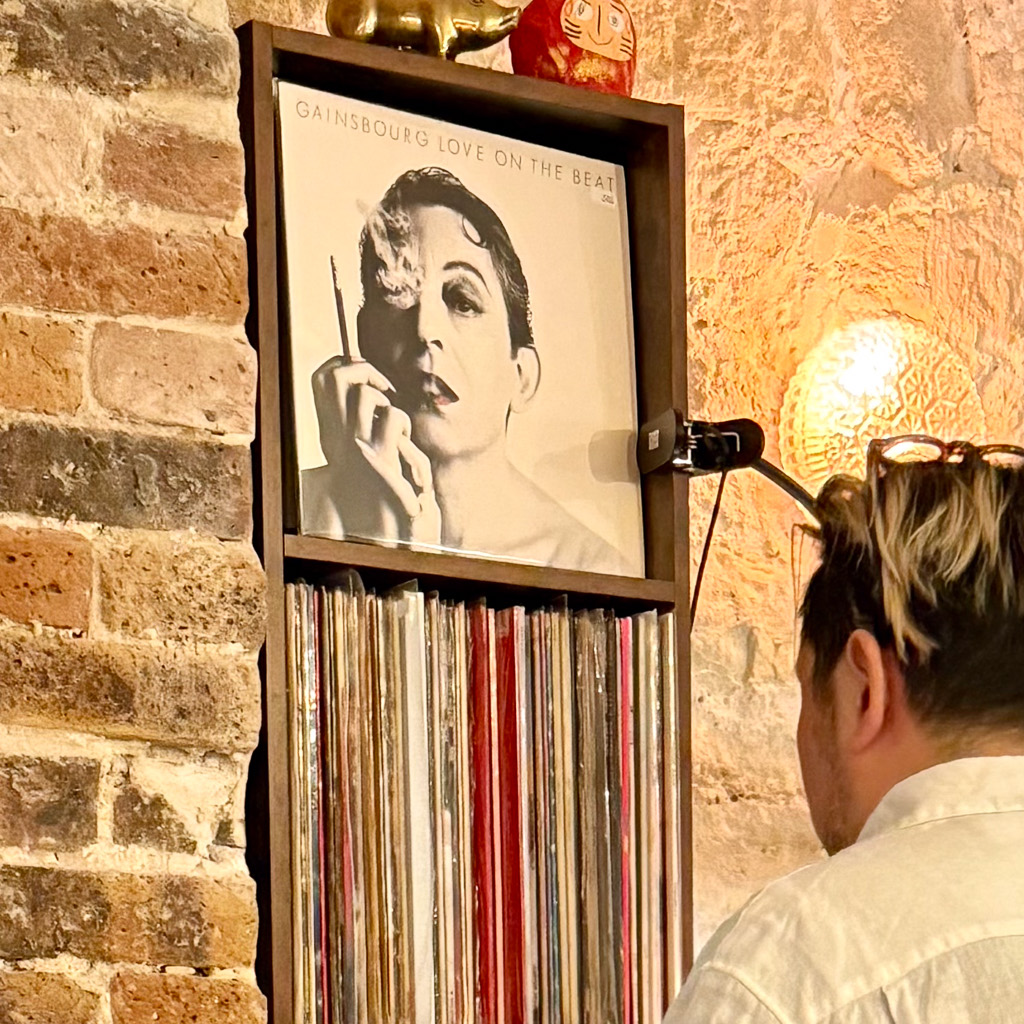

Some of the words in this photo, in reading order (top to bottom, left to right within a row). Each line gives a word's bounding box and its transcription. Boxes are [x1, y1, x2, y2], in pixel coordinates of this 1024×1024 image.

[296, 100, 429, 147] GAINSBOURG
[438, 136, 485, 162] LOVE
[495, 149, 522, 171] ON
[530, 157, 563, 181] THE
[573, 168, 615, 193] BEAT
